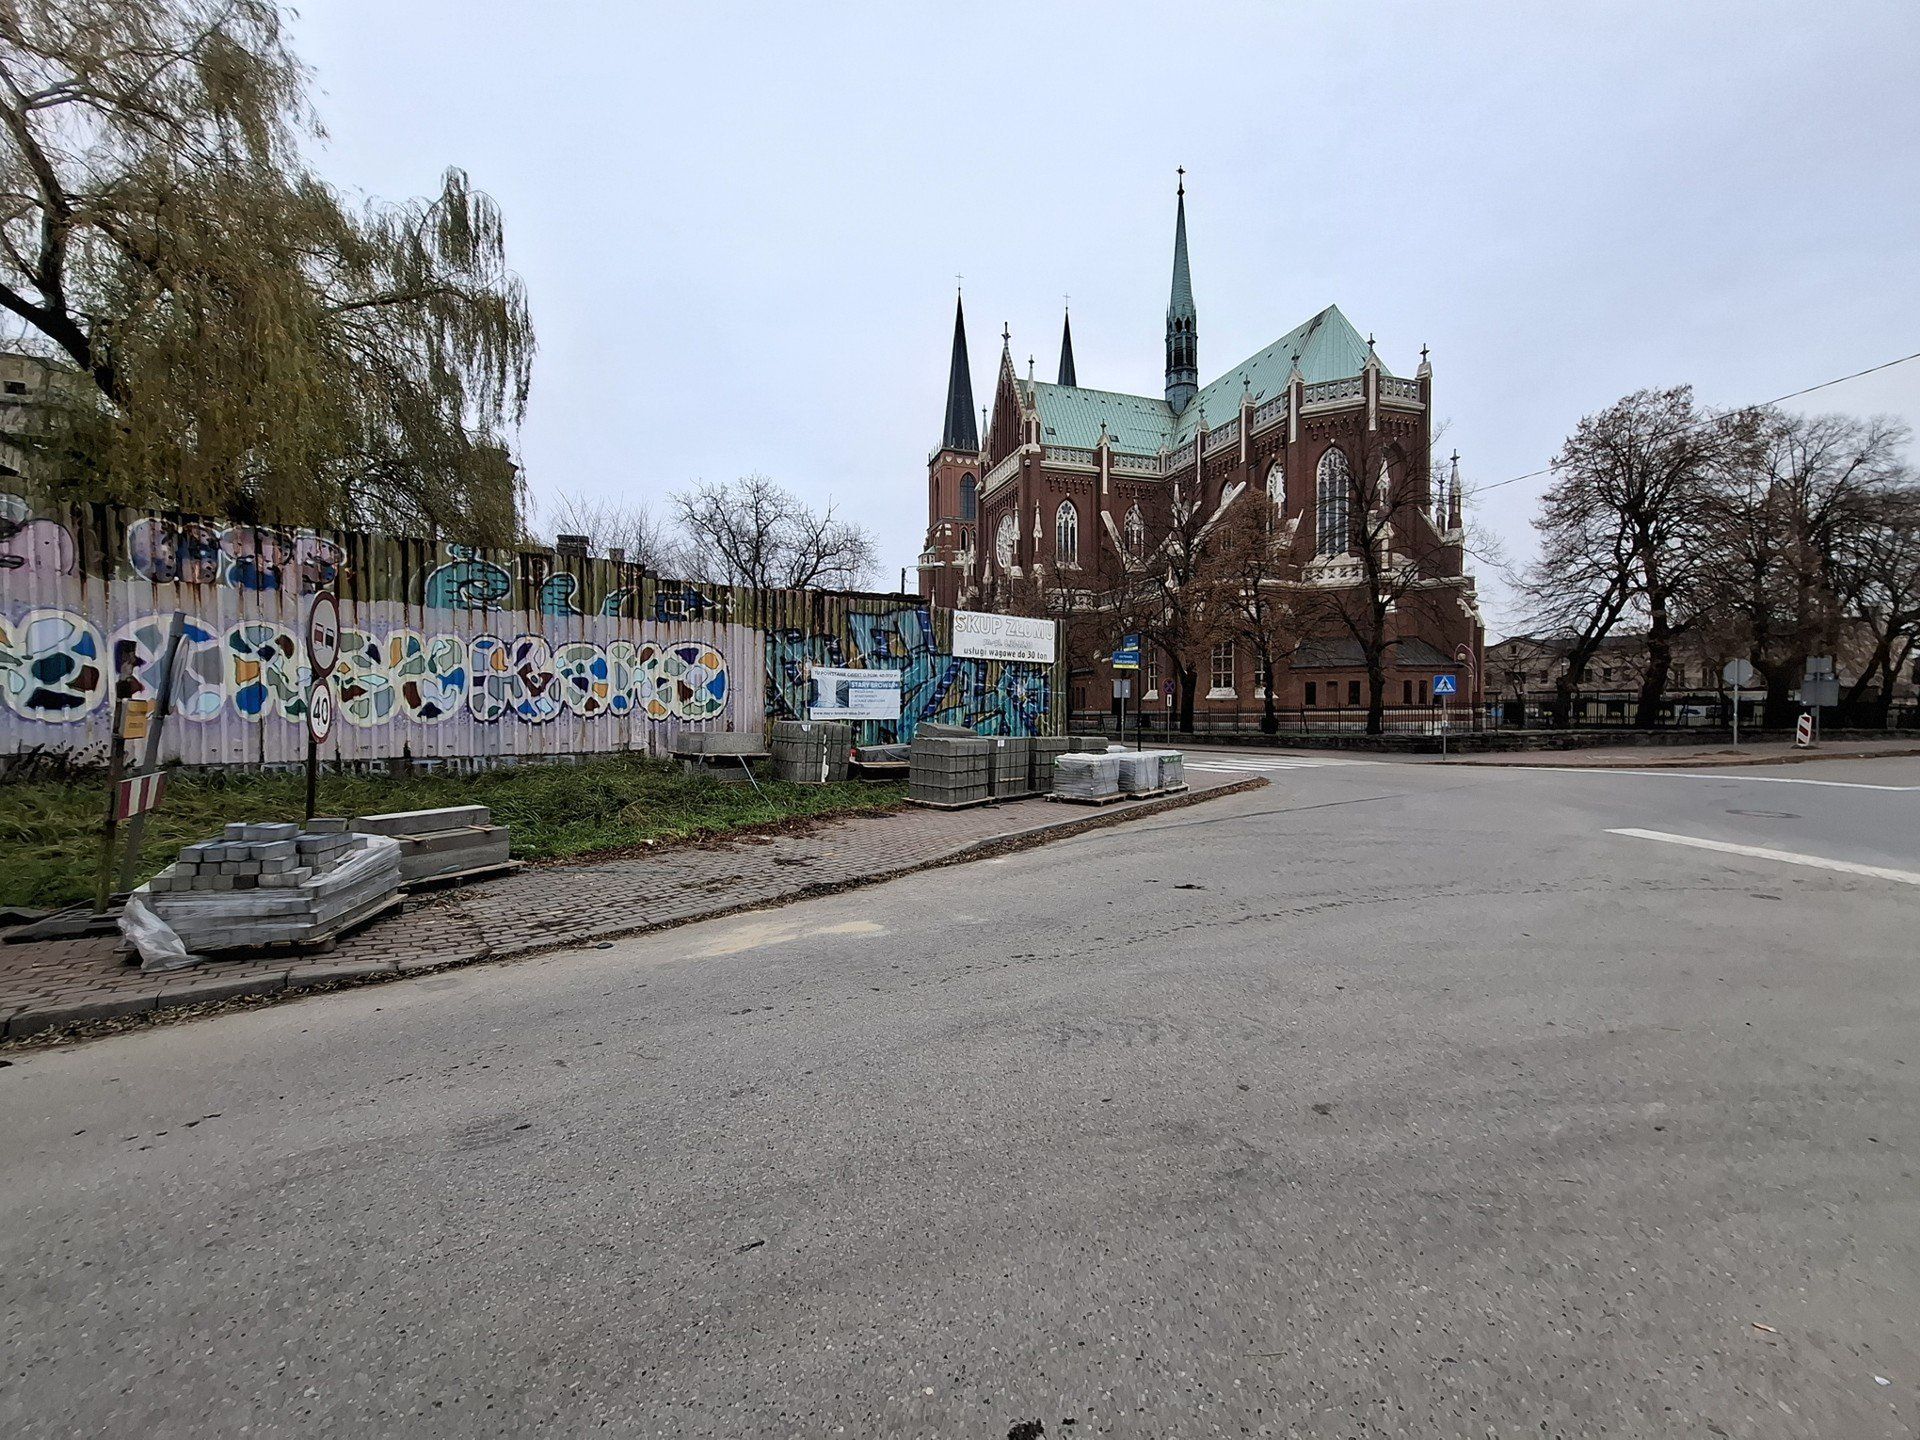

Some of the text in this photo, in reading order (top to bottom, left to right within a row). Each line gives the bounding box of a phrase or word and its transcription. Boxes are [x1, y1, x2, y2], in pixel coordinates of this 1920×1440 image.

[954, 614, 1054, 640] SKUP ZŁOMU
[963, 647, 1048, 660] usługi wagowe do 30 ton
[313, 696, 329, 726] 40
